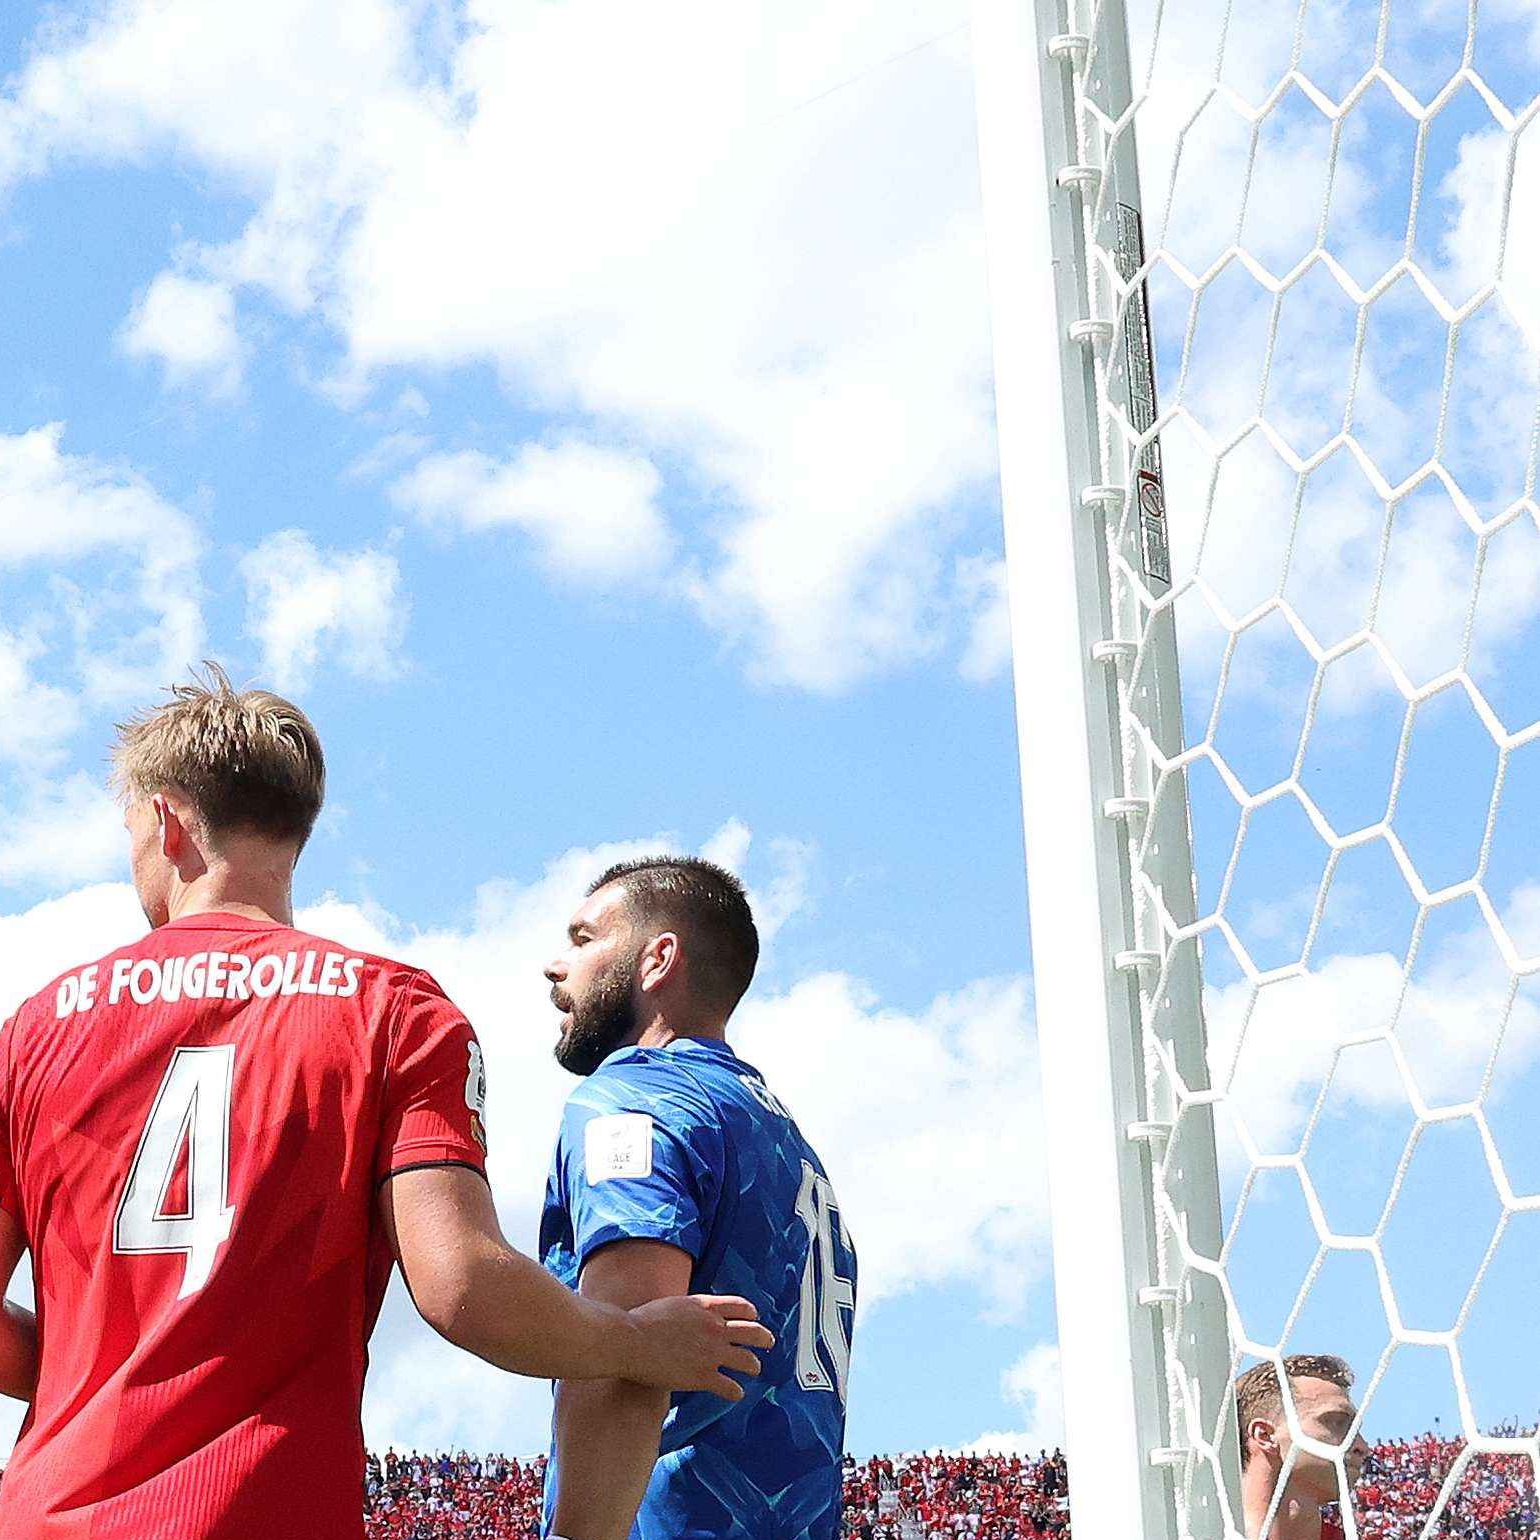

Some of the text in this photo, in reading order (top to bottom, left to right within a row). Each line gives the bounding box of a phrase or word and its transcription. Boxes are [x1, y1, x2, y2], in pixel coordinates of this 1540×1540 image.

[56, 950, 364, 1019] DE FOUGEROLLES
[112, 1042, 237, 1302] 4
